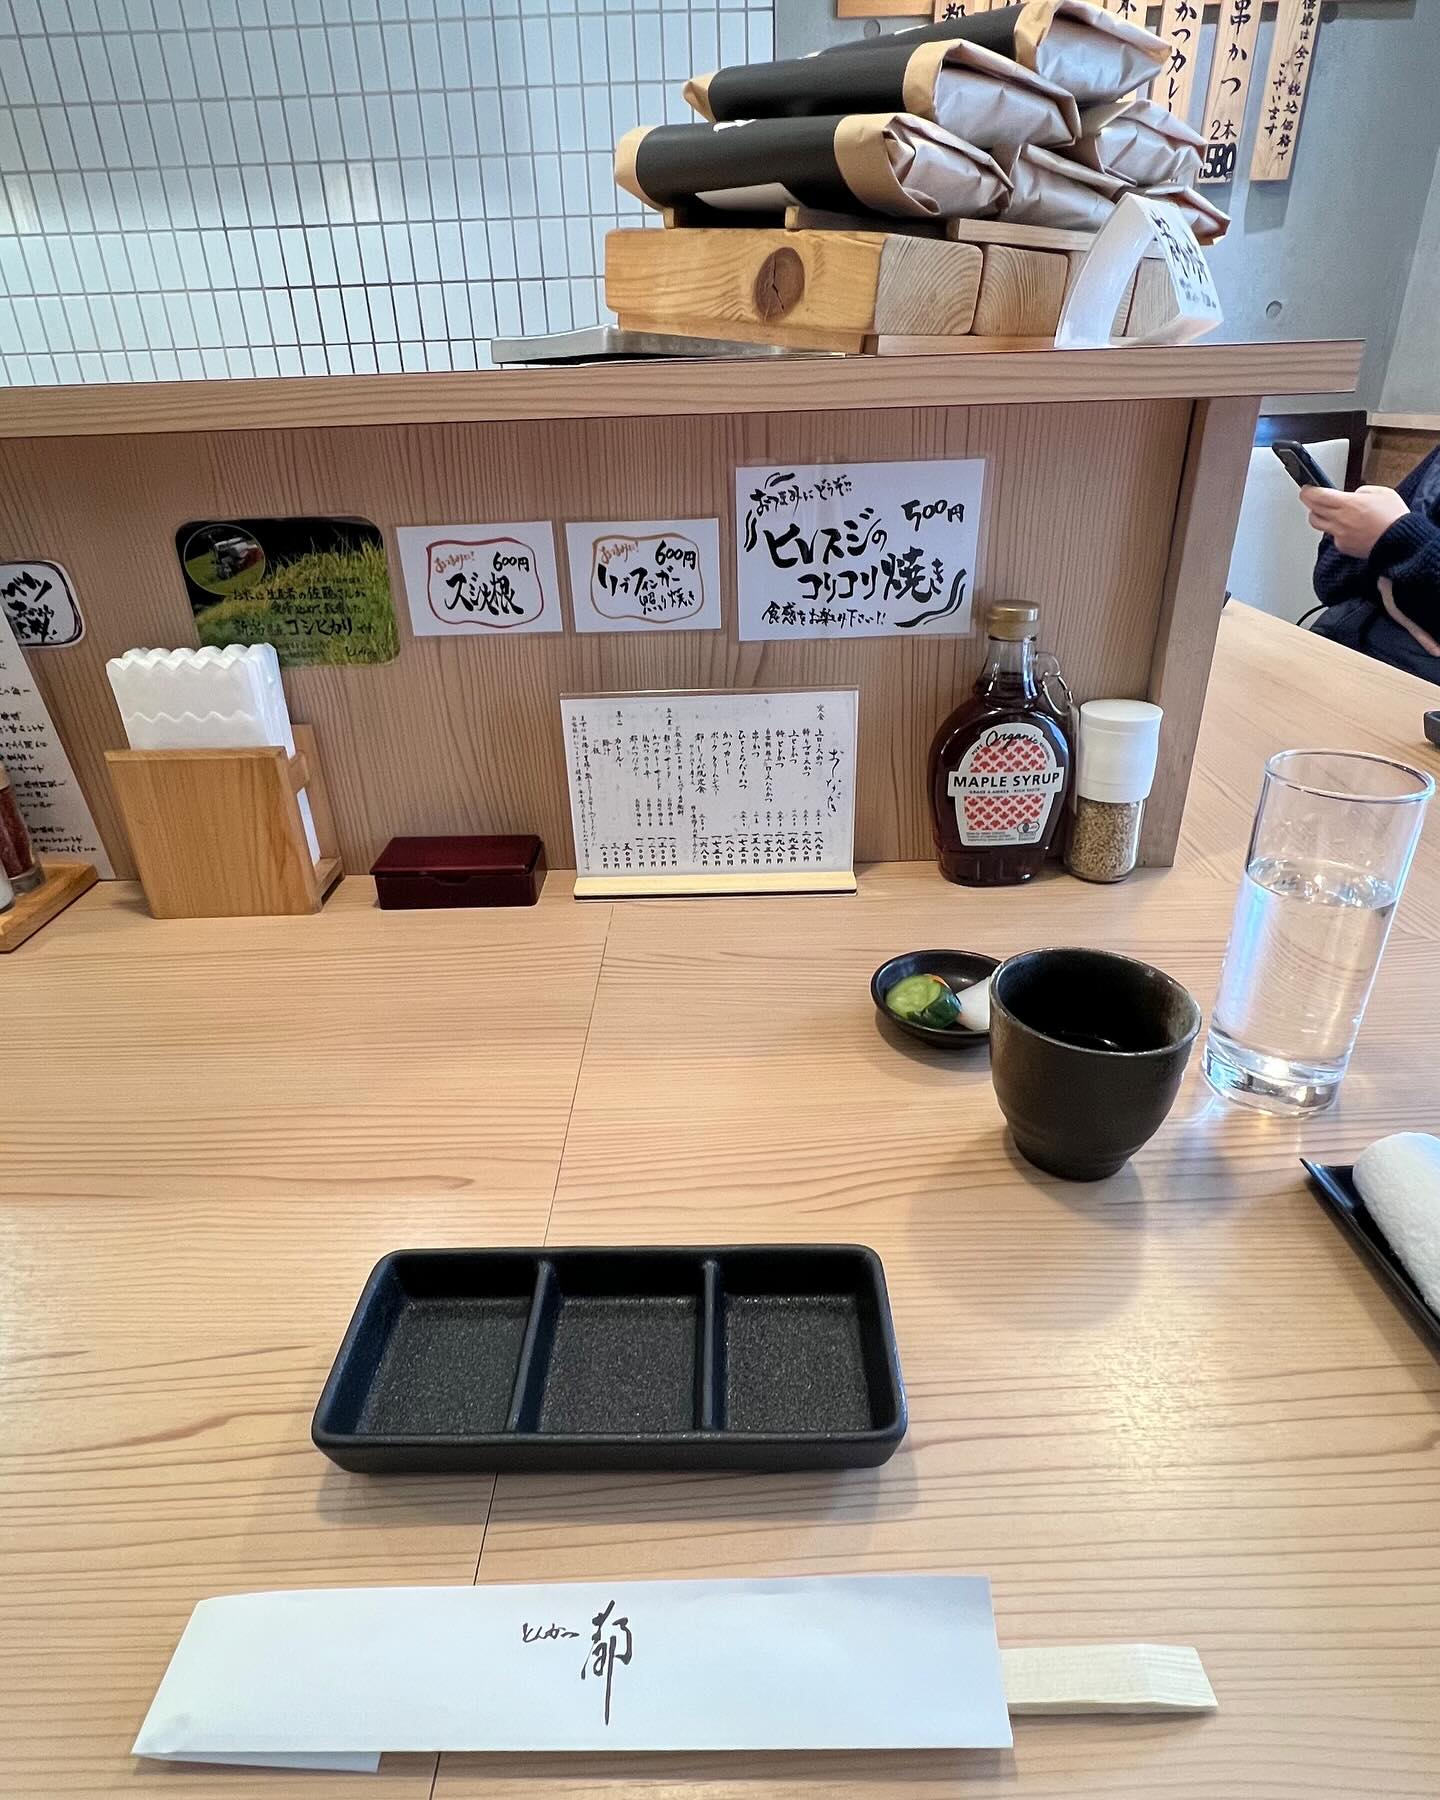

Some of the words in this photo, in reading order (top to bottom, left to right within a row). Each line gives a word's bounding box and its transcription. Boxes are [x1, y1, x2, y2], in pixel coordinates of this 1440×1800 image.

[1220, 0, 1251, 97] 串かつ
[1210, 119, 1238, 141] 2本
[901, 499, 965, 532] 500円
[763, 507, 888, 568] ヒレスジの
[492, 551, 530, 573] 600円
[655, 539, 697, 570] 600円
[597, 563, 681, 597] リブフィンガー
[797, 545, 945, 603] コリコリ焼き
[985, 730, 1039, 750] Organic
[953, 775, 1008, 788] MAPLE
[1012, 772, 1060, 787] SYRUP
[580, 1599, 633, 1726] 都
